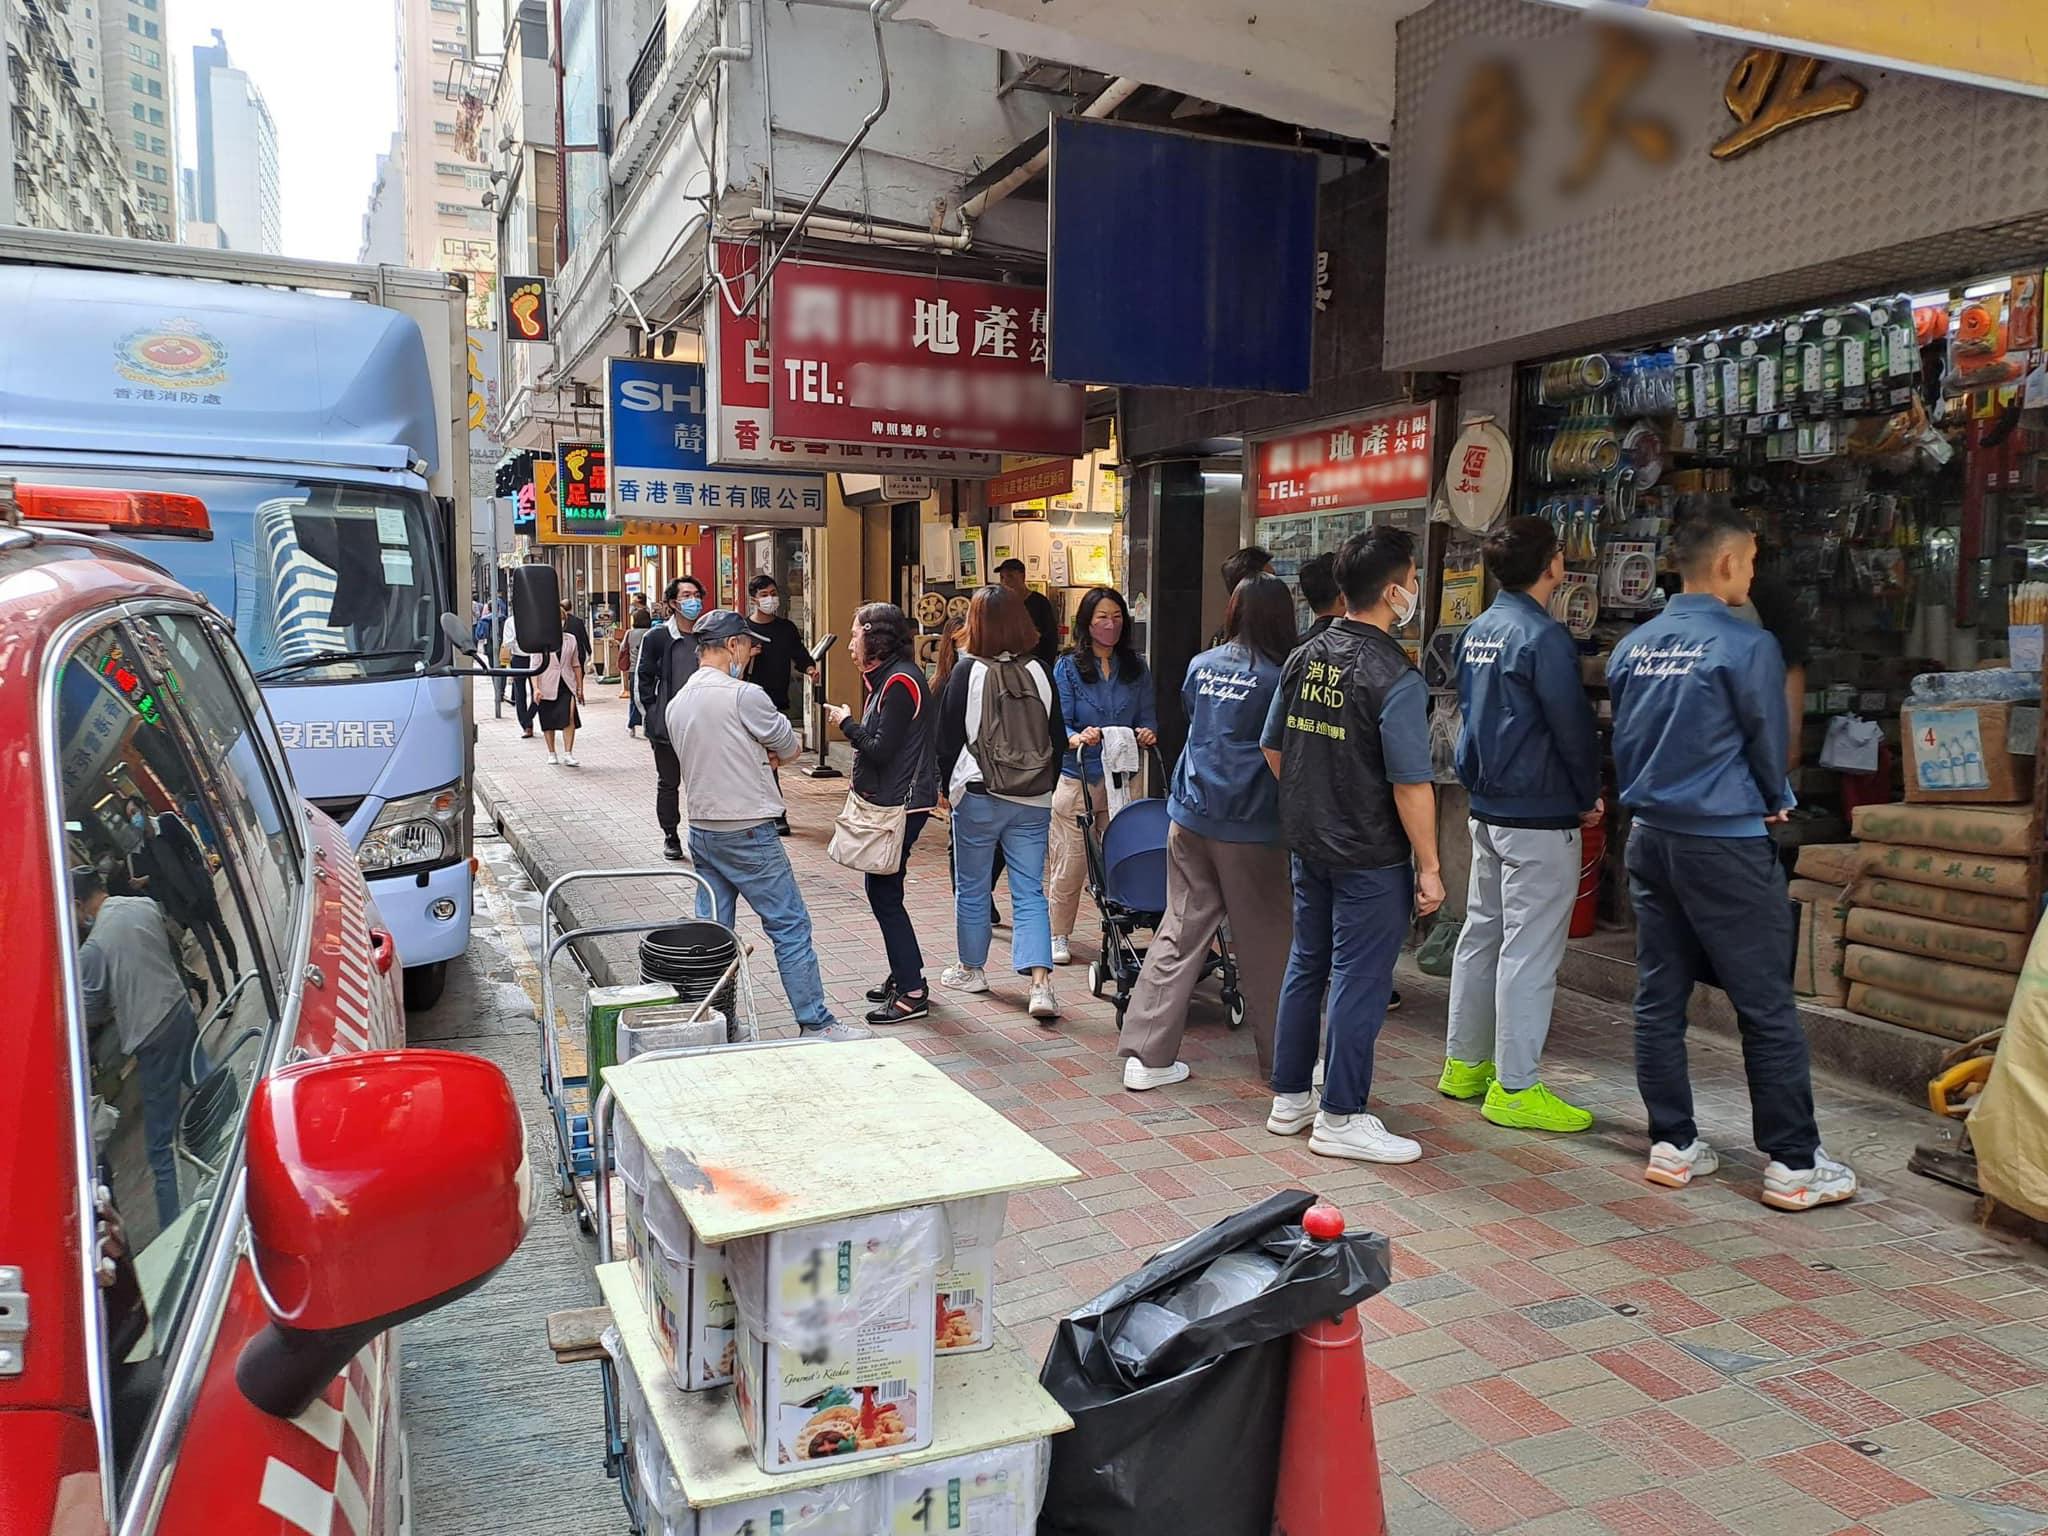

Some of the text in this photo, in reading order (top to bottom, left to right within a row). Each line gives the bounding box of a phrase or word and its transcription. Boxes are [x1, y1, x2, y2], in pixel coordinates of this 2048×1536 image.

[784, 358, 844, 405] TEL:
[113, 387, 223, 406] 香港消防處
[620, 379, 705, 415] SH
[871, 420, 927, 438] 牌照號碼
[1328, 424, 1390, 462] 地產
[617, 479, 822, 511] 香港雪柜有限公司
[1268, 479, 1304, 500] TEL:
[1629, 643, 1704, 663] We join hands
[1197, 667, 1259, 688] We join hands
[1305, 660, 1343, 688] 消防
[1633, 661, 1695, 680] We defend
[1198, 684, 1251, 702] We defend
[276, 720, 396, 749] 安居保民
[1924, 727, 1937, 748] 4
